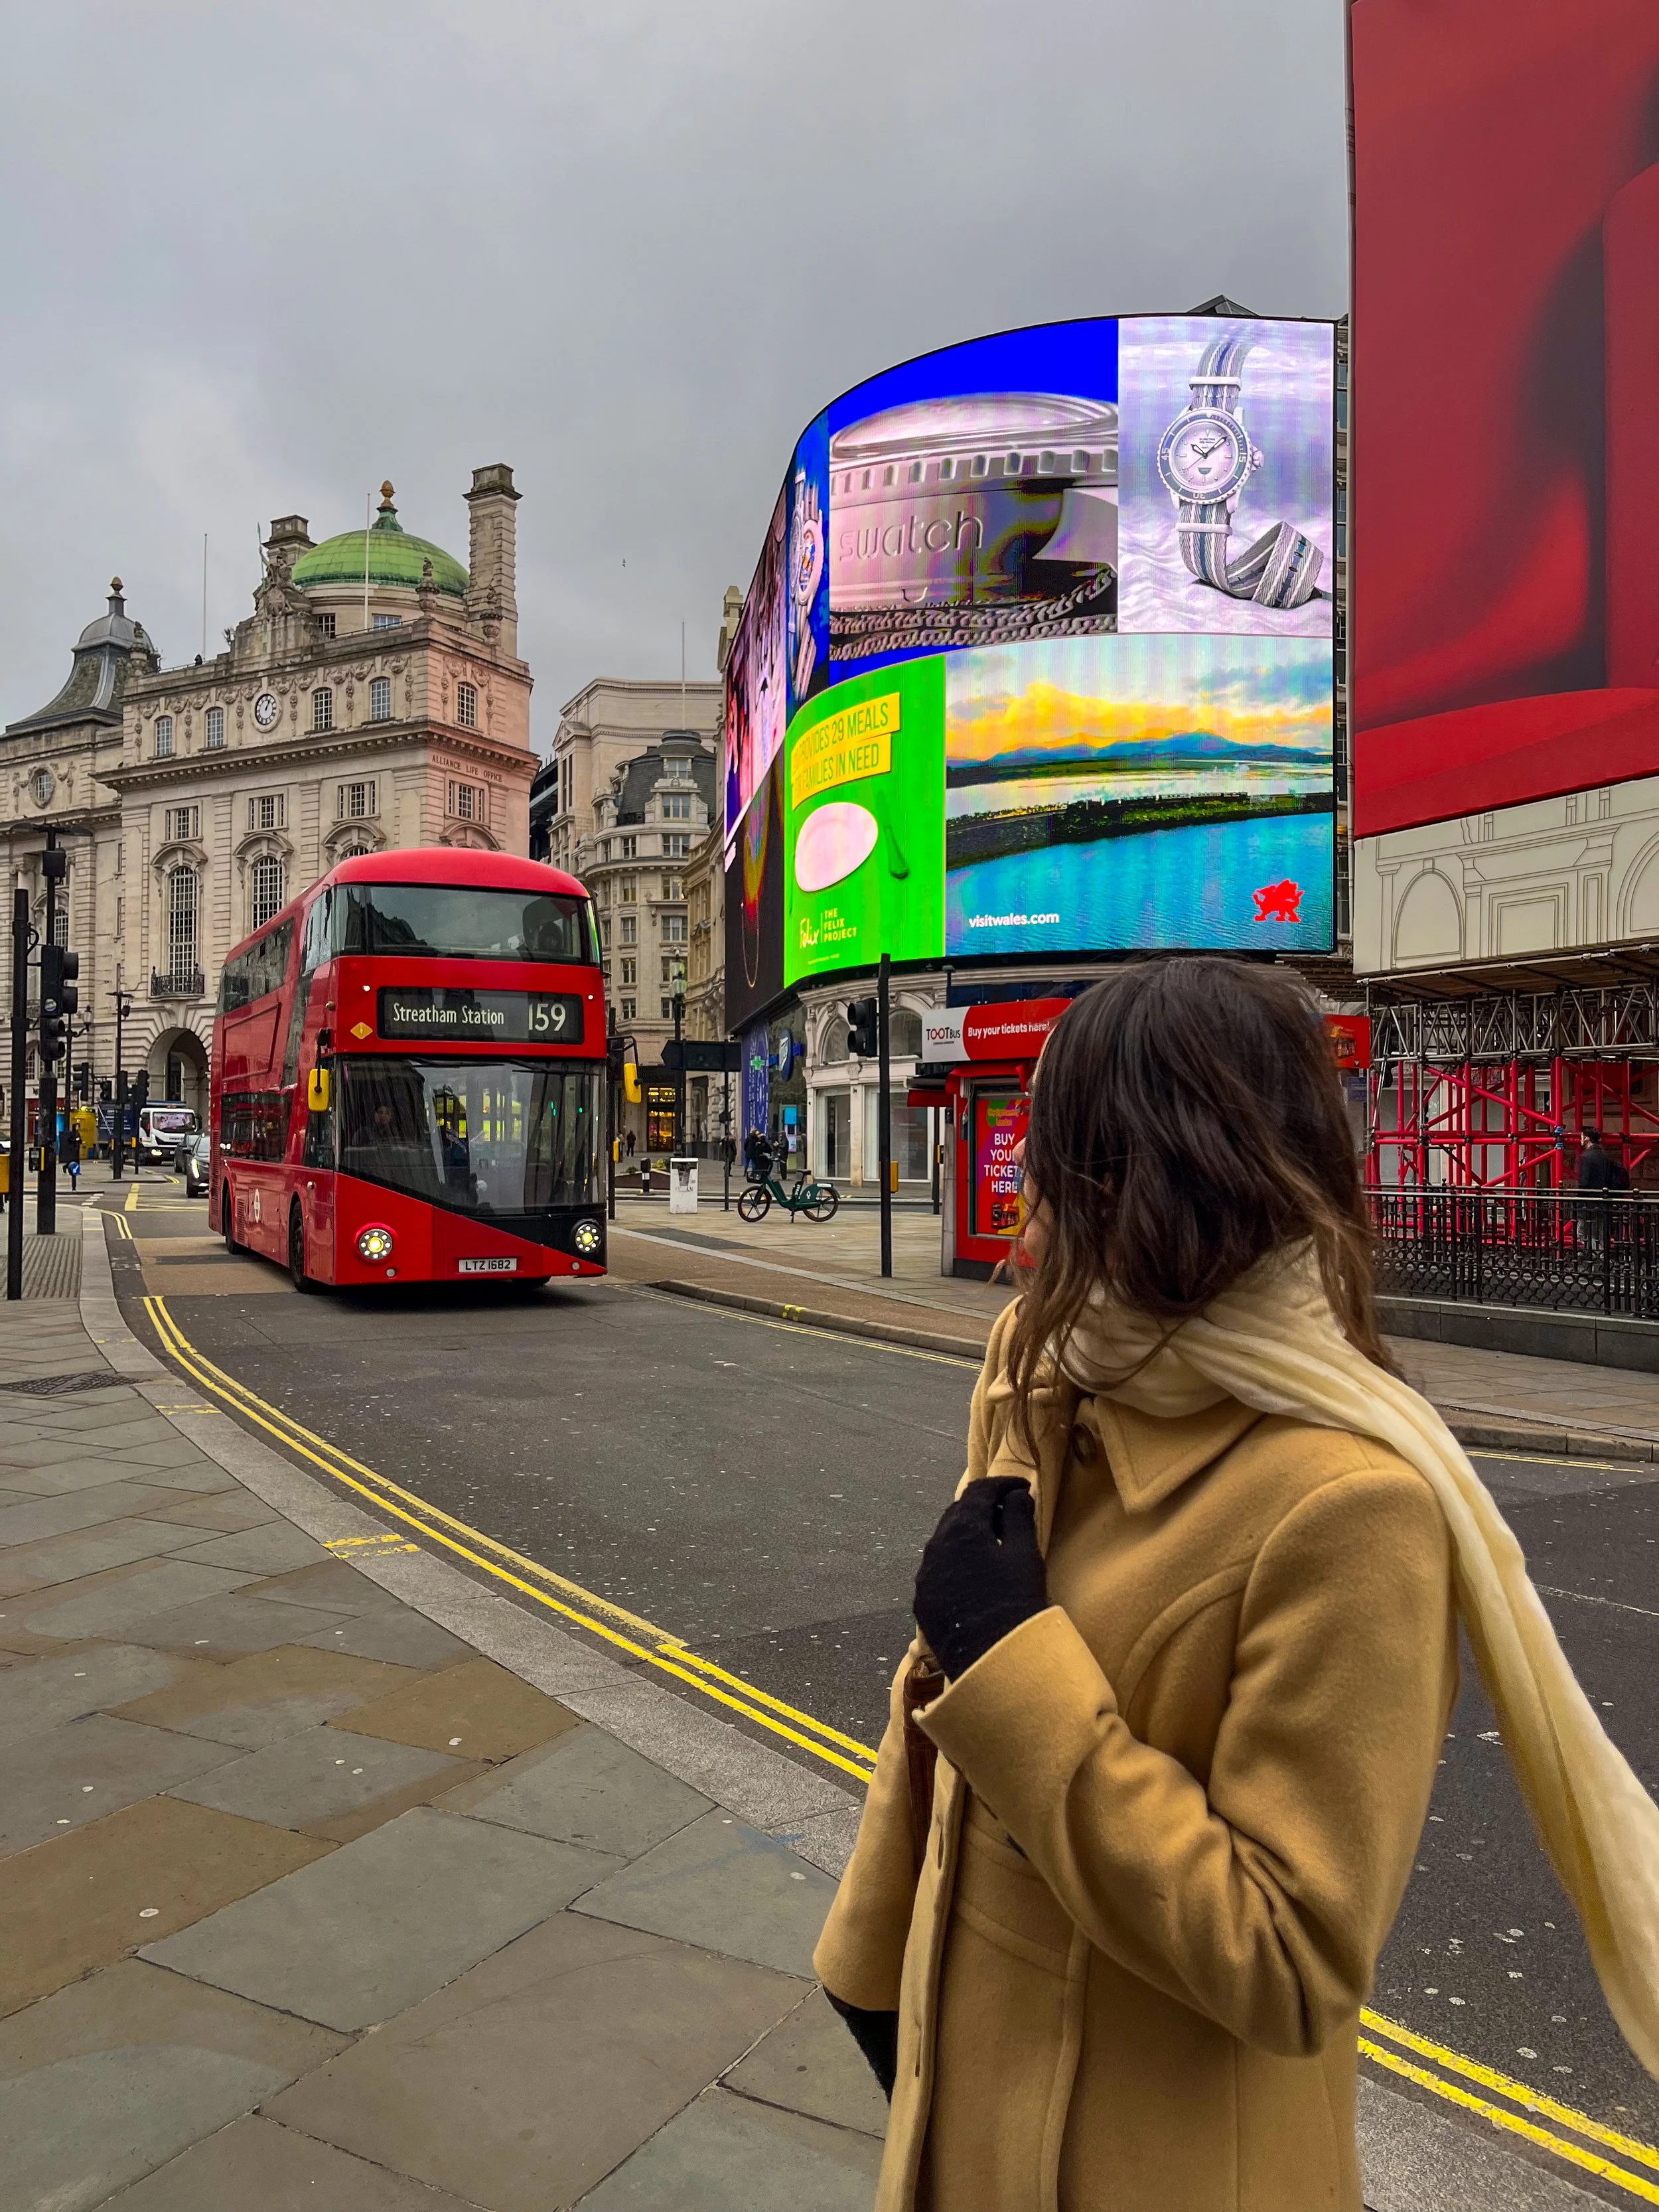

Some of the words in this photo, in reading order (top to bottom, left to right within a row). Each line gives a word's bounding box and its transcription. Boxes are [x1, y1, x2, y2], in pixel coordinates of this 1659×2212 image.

[839, 510, 983, 561] swatch
[831, 717, 844, 745] 29
[847, 702, 888, 739] MEALS
[432, 755, 461, 770] ALLIANCE
[466, 764, 478, 776] LIFE
[483, 770, 503, 782] OFFICE
[835, 751, 846, 778] IN
[848, 743, 880, 774] NEED
[824, 908, 838, 920] THE
[968, 912, 1060, 928] visitwales.com
[824, 919, 845, 932] FELIX
[824, 926, 857, 942] PROJECT
[393, 1002, 457, 1023] Streatham
[462, 1005, 504, 1025] Station
[528, 1003, 567, 1031] 159
[968, 1027, 982, 1039] Buy
[983, 1025, 999, 1039] your
[1001, 1023, 1028, 1035] tickets
[994, 1133, 1015, 1145] BUY
[991, 1181, 1018, 1193] HERE
[465, 1260, 486, 1271] LTZ
[488, 1260, 511, 1270] 1682
